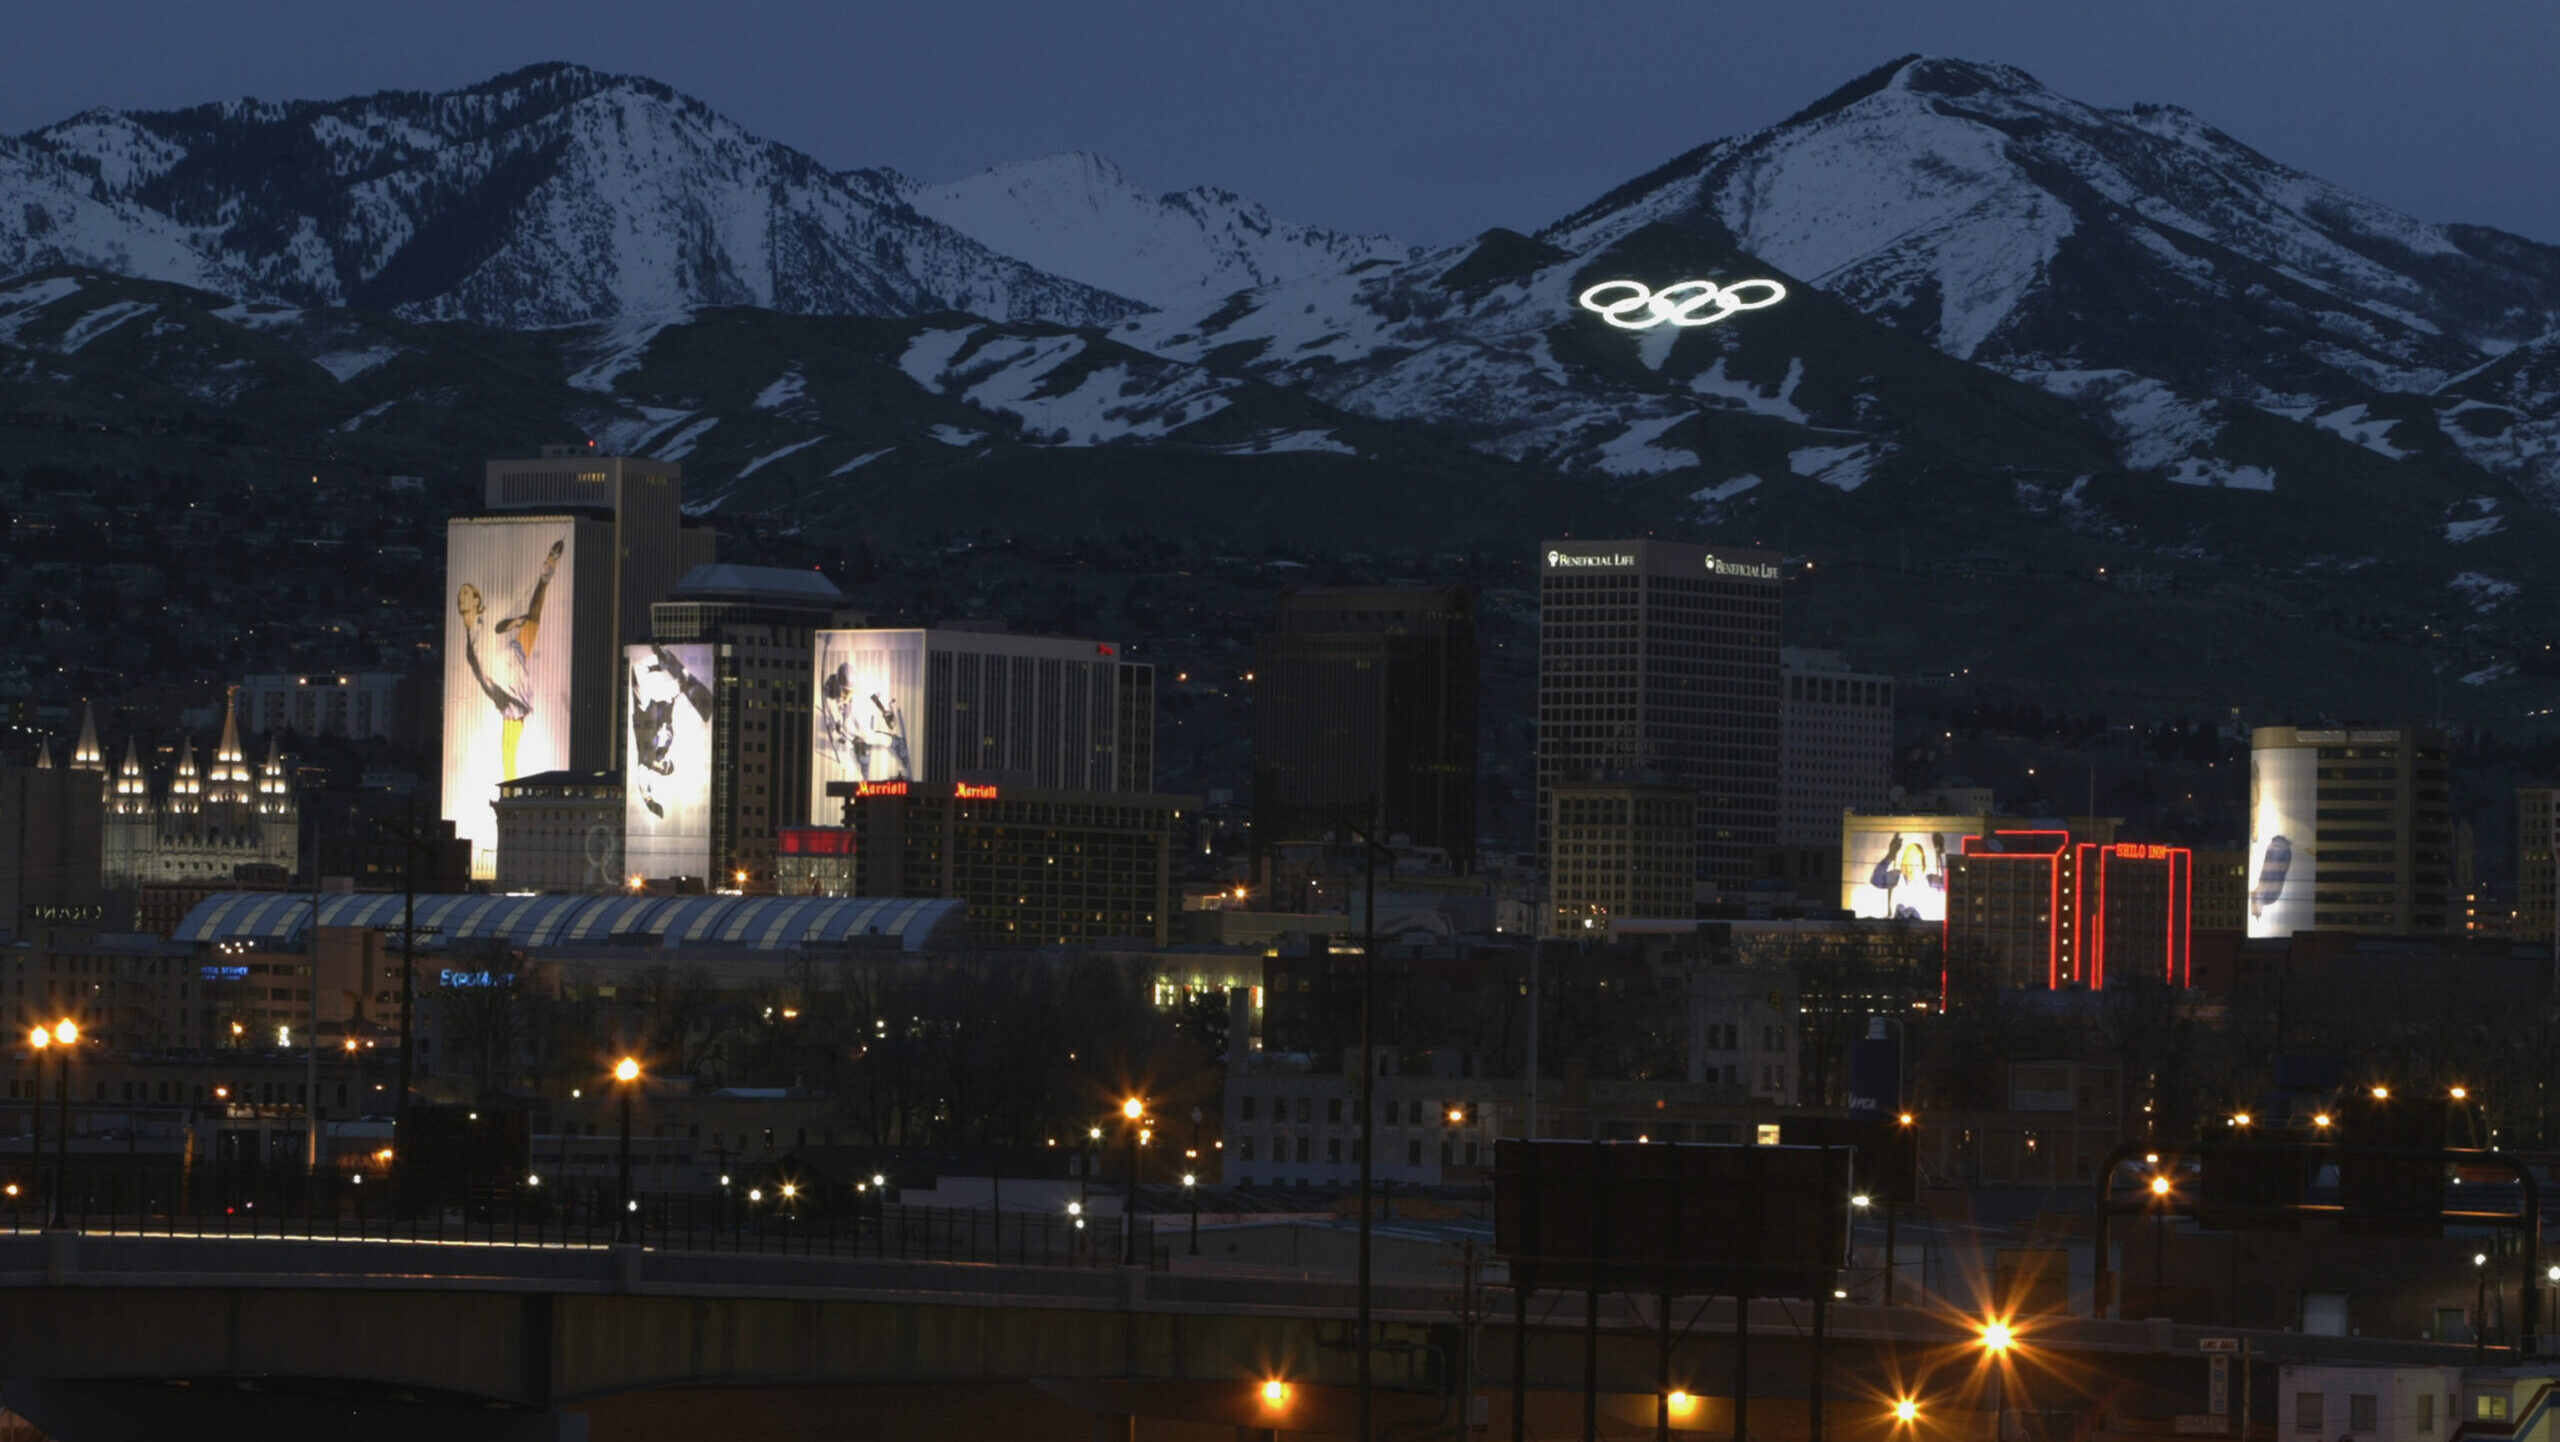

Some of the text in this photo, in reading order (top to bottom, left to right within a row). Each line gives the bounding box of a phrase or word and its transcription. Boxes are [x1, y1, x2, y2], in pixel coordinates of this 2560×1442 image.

[1560, 553, 1635, 567] BENEFICIAL LIFE
[856, 781, 907, 796] Marriott
[955, 782, 997, 798] Marriott
[2116, 843, 2166, 859] SHILO INN
